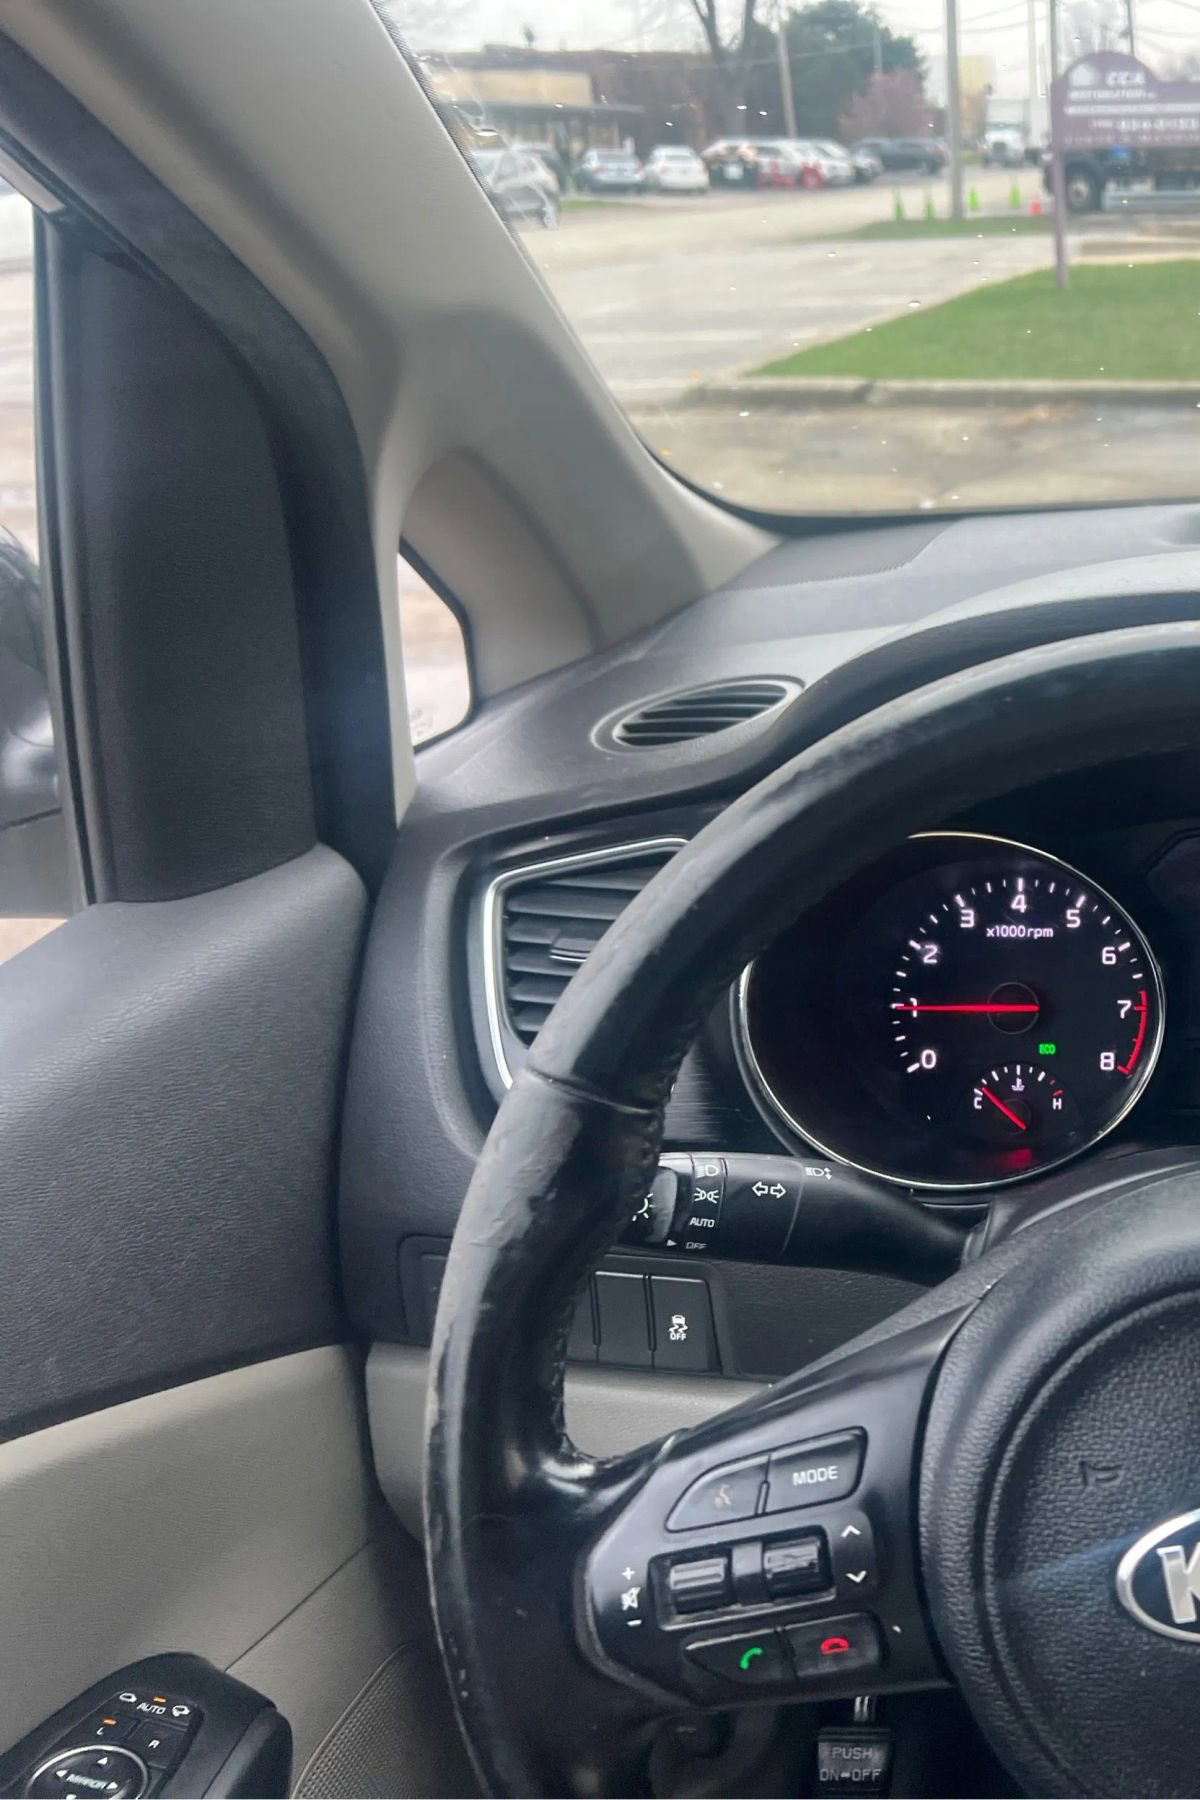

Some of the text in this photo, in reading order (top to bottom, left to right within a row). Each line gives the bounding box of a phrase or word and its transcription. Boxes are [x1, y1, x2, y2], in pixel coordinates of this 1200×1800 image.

[1010, 894, 1027, 913] 4
[960, 909, 975, 928] 3
[1066, 909, 1081, 928] 5
[986, 926, 1053, 940] x1000 rpm
[923, 945, 939, 964] 2
[1101, 946, 1117, 965] 6
[909, 997, 918, 1018] 1
[1117, 999, 1132, 1019] 7
[1038, 1044, 1057, 1055] ECO
[921, 1050, 936, 1069] 0
[1099, 1051, 1115, 1071] 8
[973, 1097, 983, 1110] C
[1052, 1098, 1063, 1111] H
[689, 1217, 715, 1228] AUTO
[686, 1241, 708, 1250] OFF
[669, 1332, 688, 1341] OFF
[792, 1466, 839, 1487] MODE
[136, 1702, 167, 1715] AUTO
[831, 1746, 873, 1760] PUSH
[820, 1768, 882, 1782] ON-OFF
